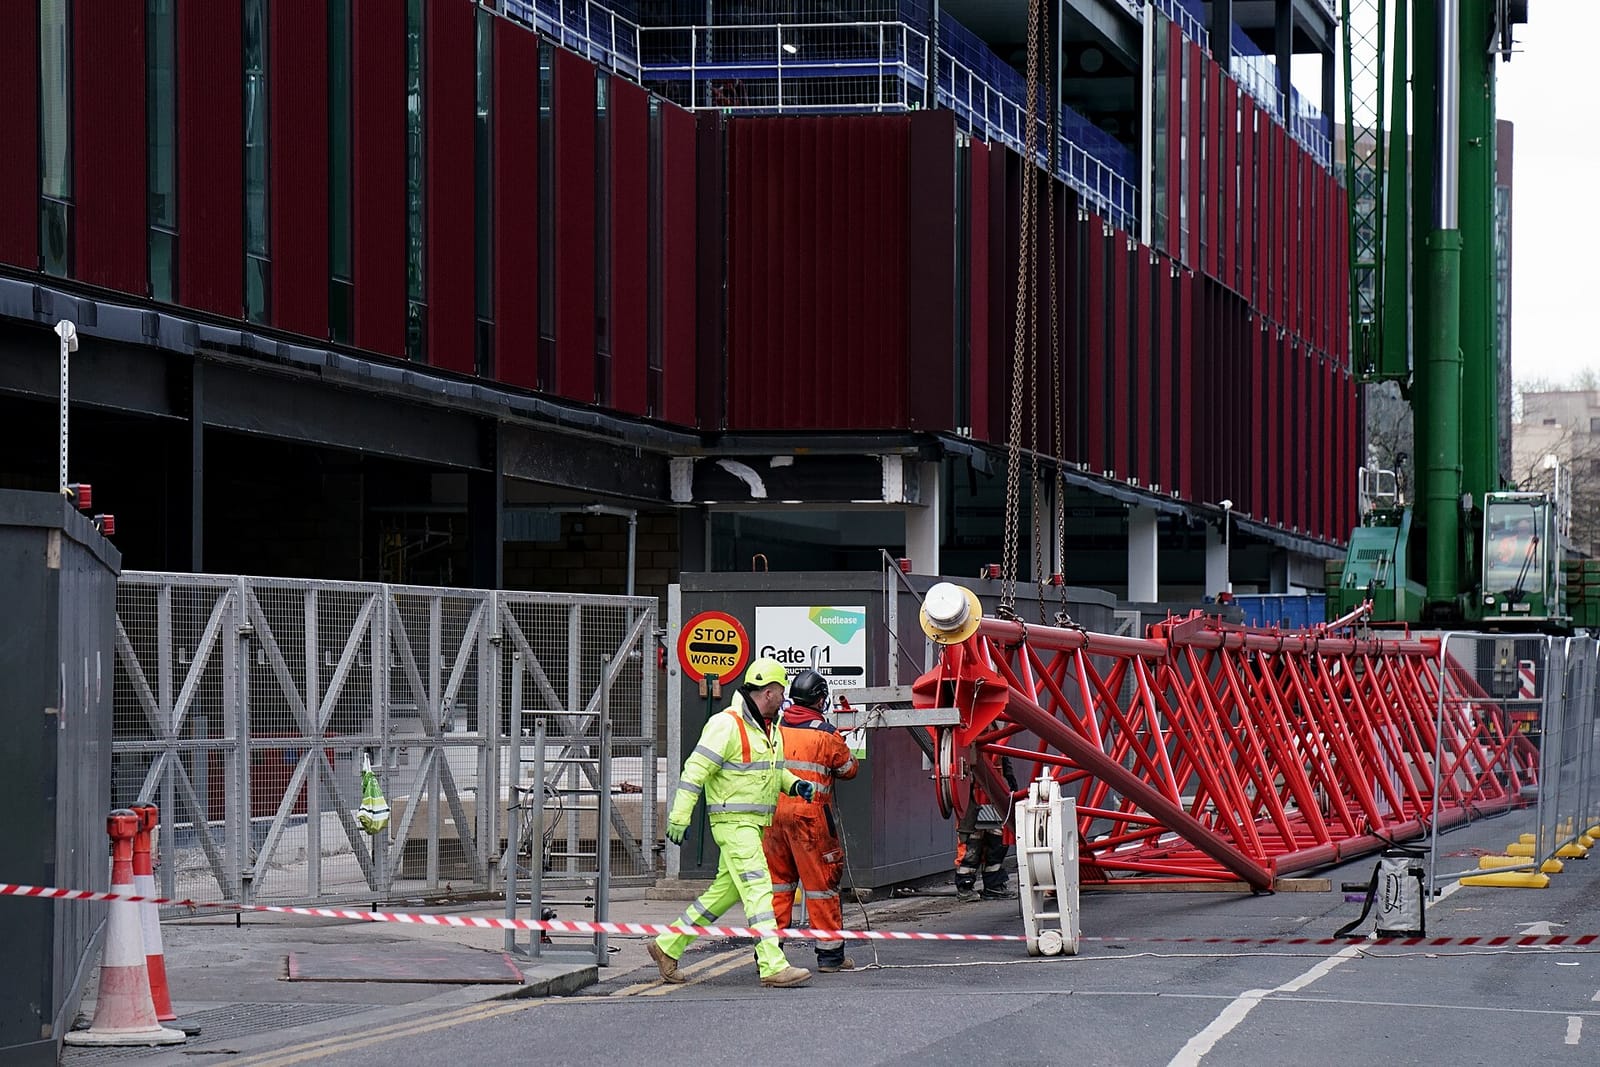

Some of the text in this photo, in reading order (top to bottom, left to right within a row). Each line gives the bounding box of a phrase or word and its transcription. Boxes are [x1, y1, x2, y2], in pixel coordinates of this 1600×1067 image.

[820, 615, 858, 625] lendlease
[693, 628, 736, 642] STOP
[760, 645, 805, 663] Gate
[691, 655, 735, 666] WORKS
